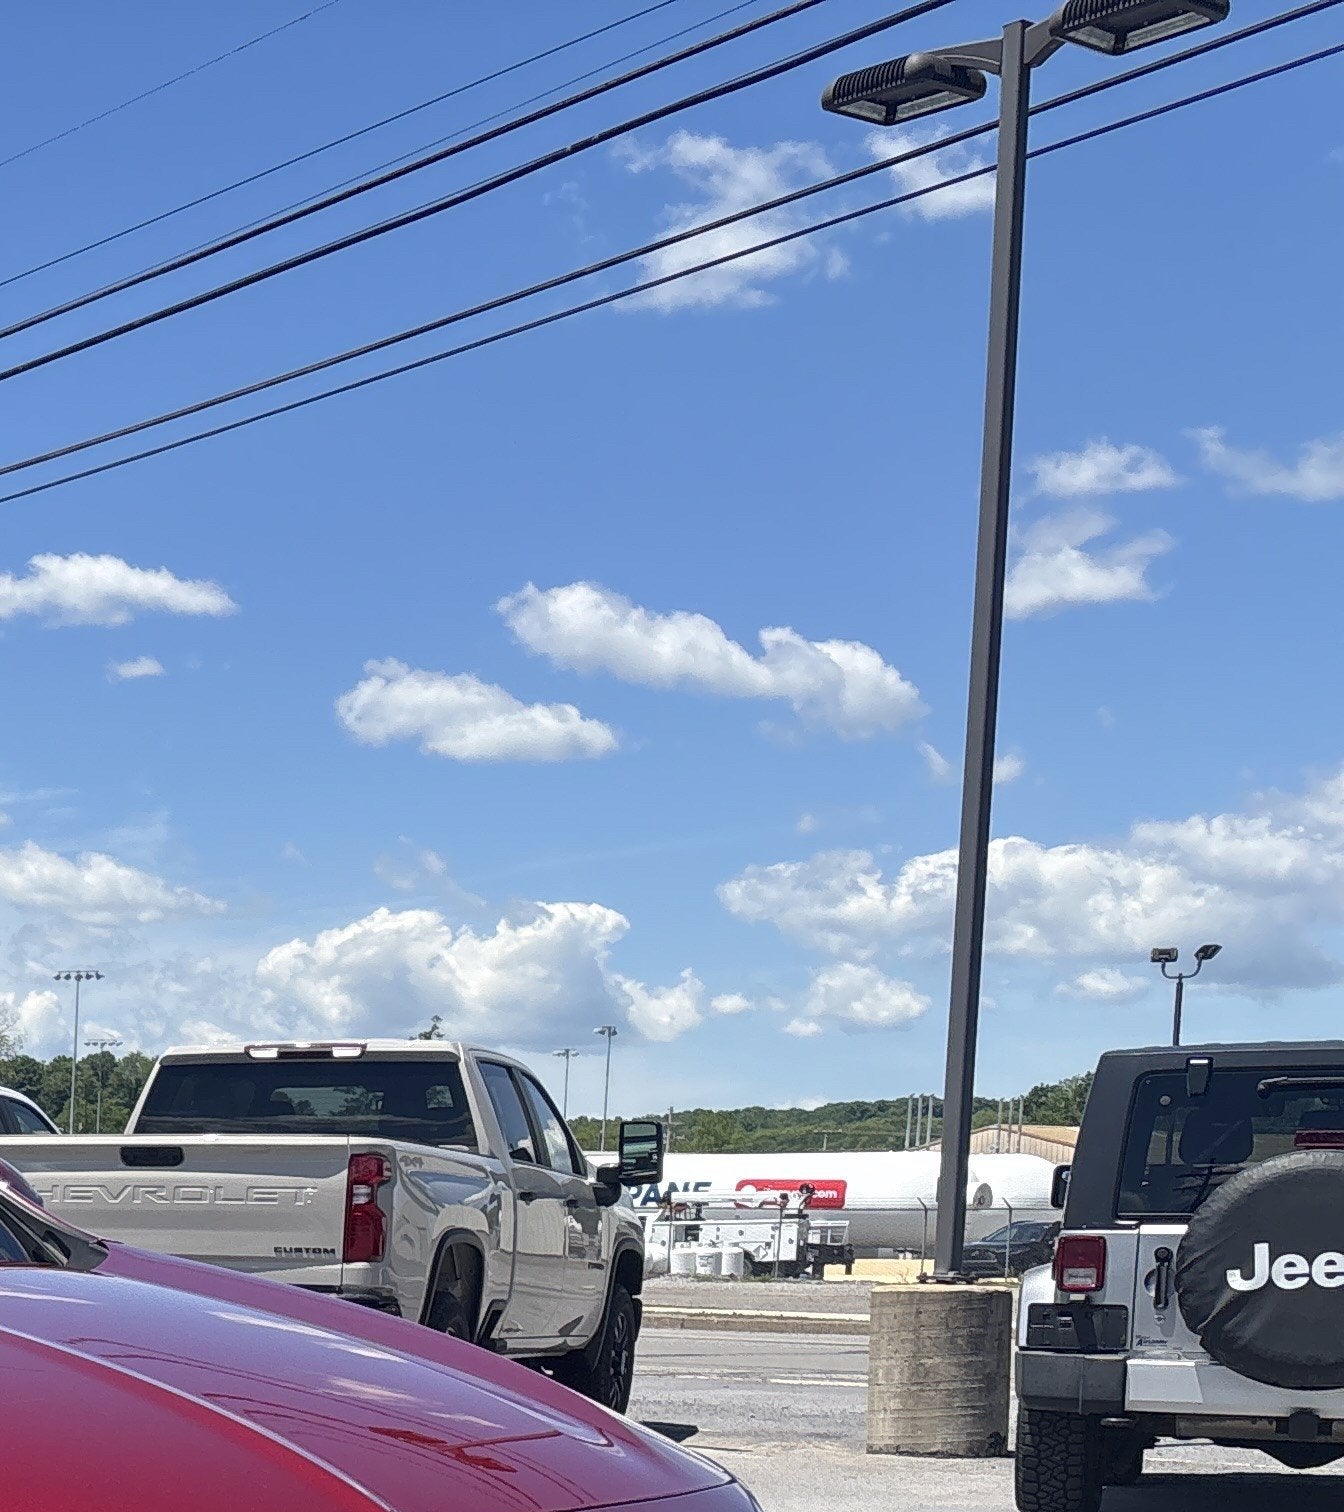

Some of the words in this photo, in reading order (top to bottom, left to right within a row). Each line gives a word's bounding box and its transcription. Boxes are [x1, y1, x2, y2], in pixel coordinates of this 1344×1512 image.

[36, 1184, 318, 1206] HEVROLET
[273, 1246, 336, 1256] CUSTOM
[1226, 1242, 1344, 1291] Jee
